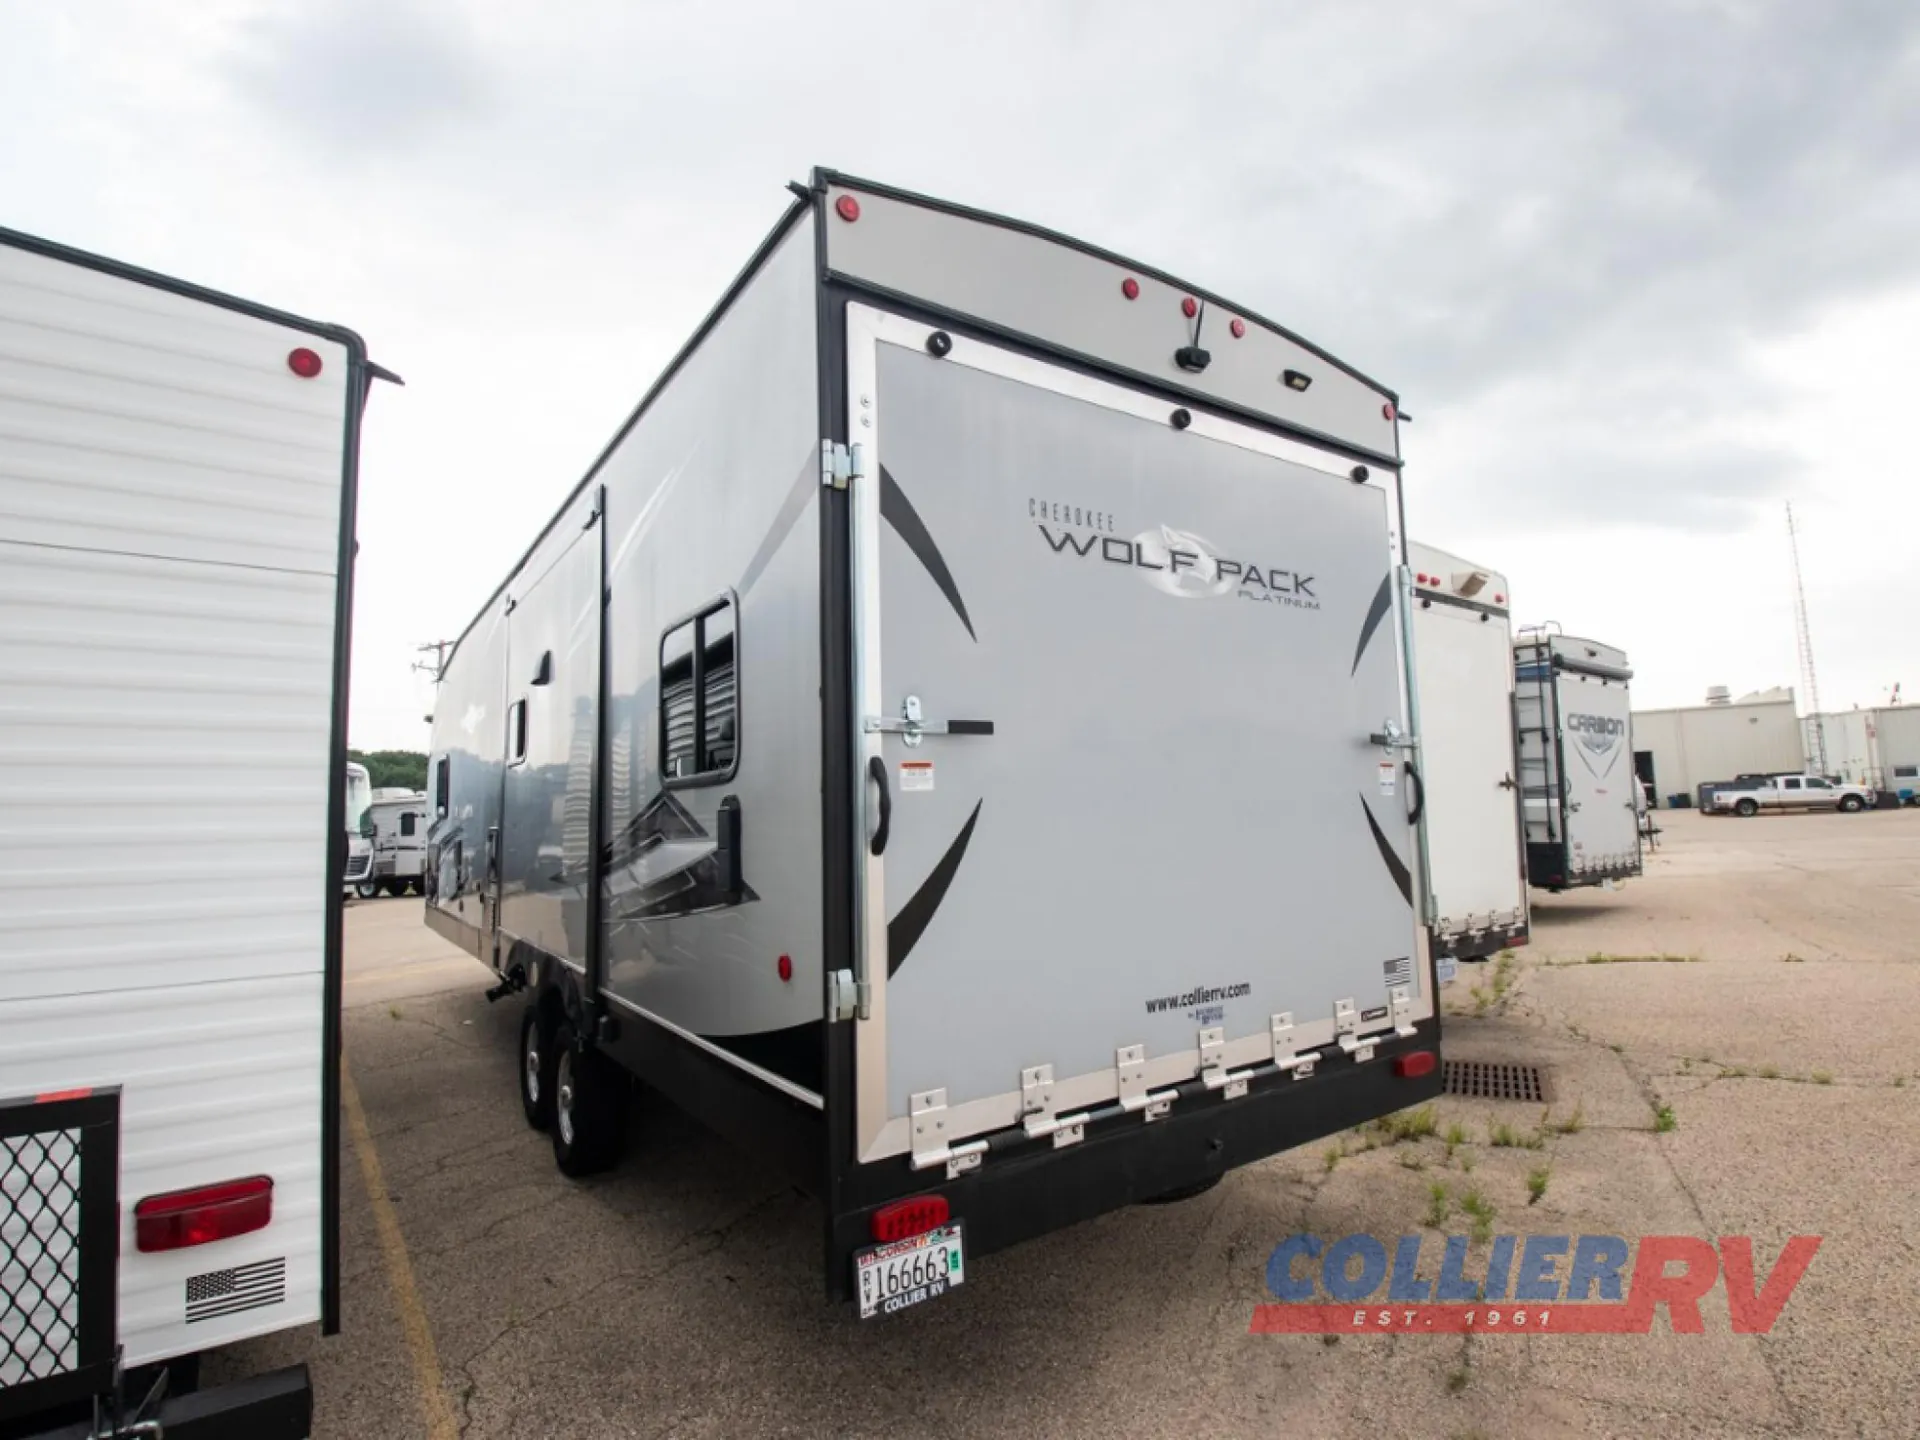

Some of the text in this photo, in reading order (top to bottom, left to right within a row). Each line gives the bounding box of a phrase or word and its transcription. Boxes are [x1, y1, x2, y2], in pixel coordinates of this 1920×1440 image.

[1028, 498, 1115, 532] CHEROKEE
[1038, 523, 1316, 597] WOLF PACK
[1237, 590, 1321, 611] PLATINUM
[1567, 713, 1624, 737] CARBON
[1145, 982, 1251, 1014] www.collierrv.com
[876, 1246, 950, 1300] 166663
[884, 1287, 927, 1313] COLLIER
